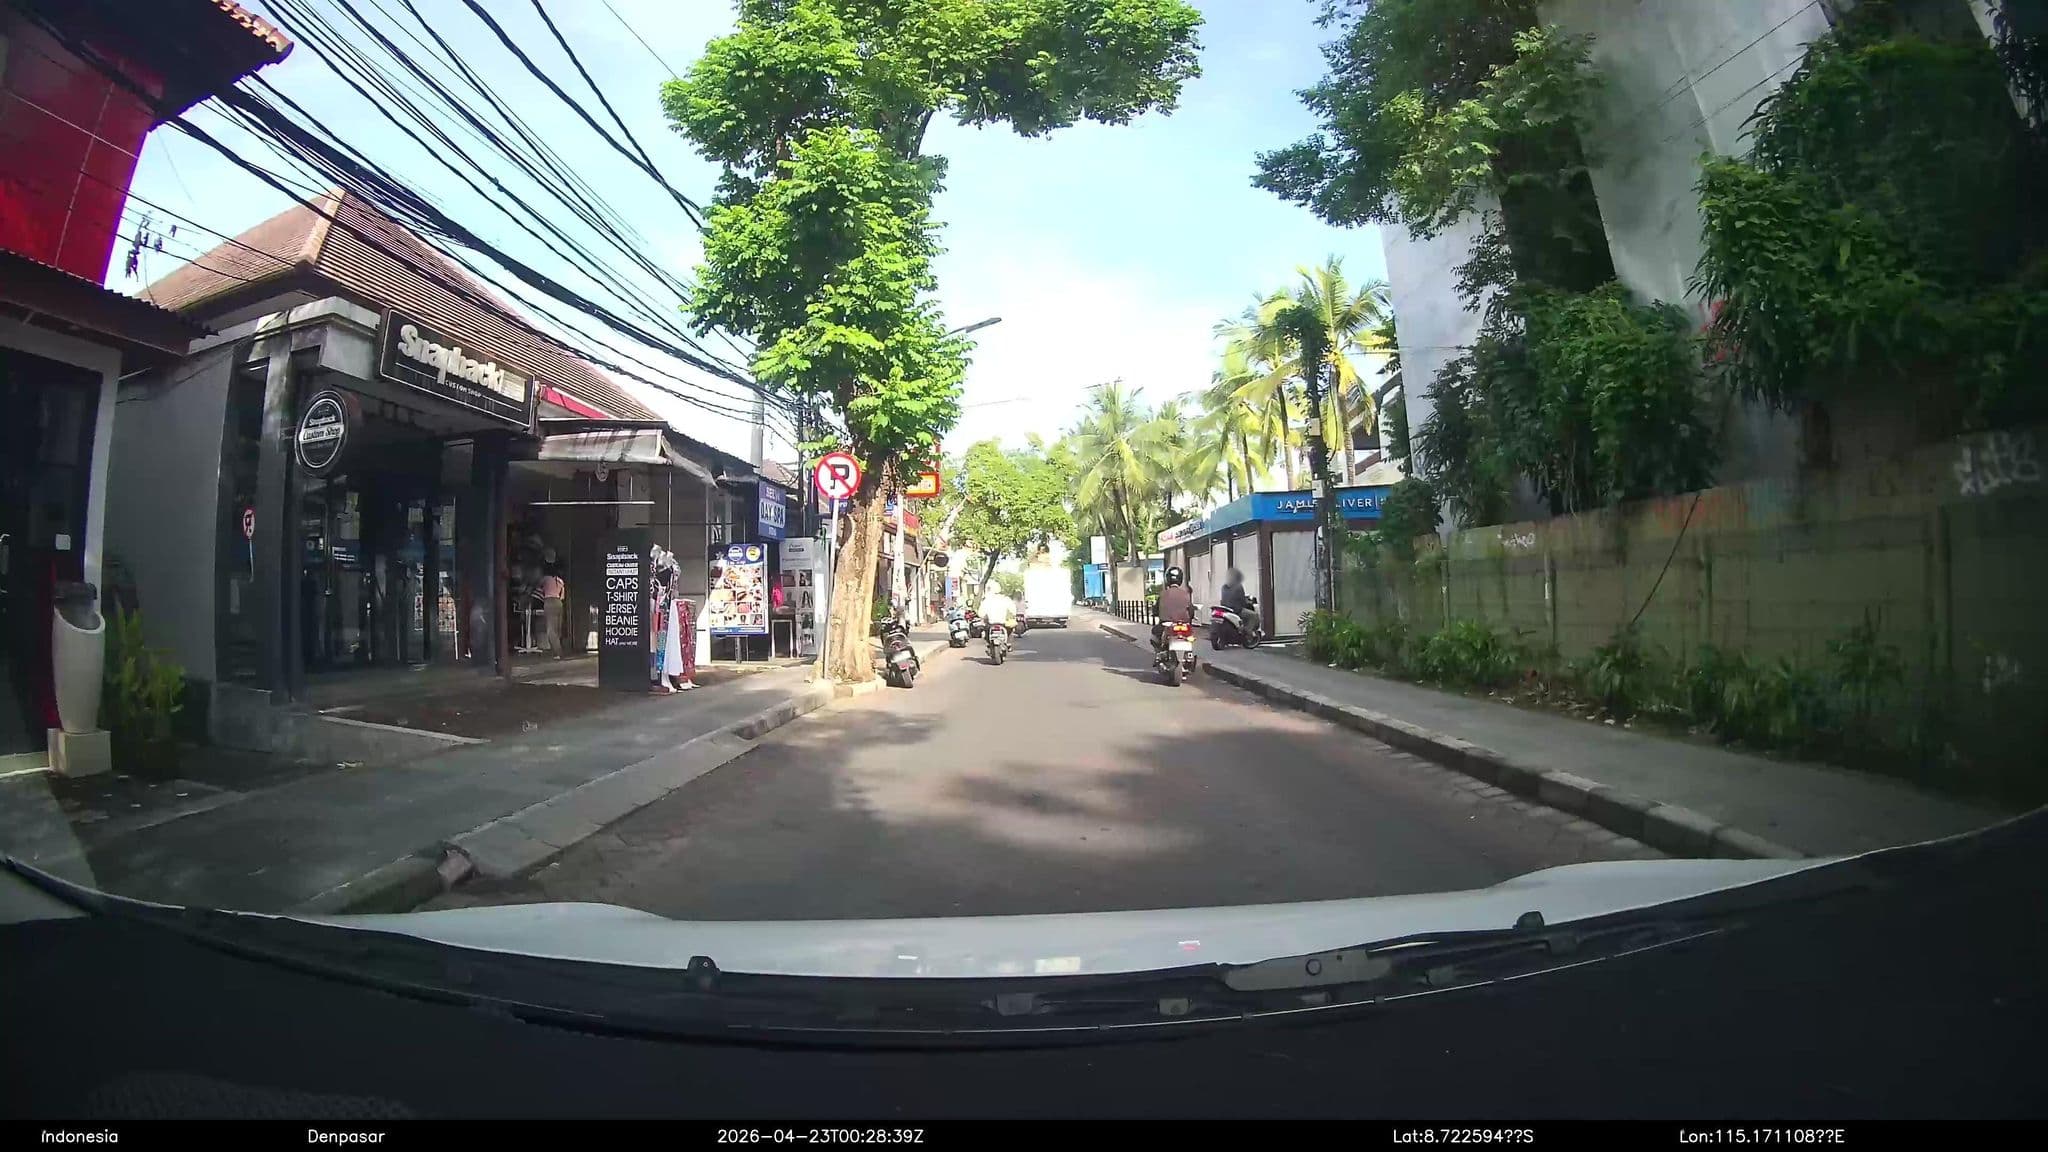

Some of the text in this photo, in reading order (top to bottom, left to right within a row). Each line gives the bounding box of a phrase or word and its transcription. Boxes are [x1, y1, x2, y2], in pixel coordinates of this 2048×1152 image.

[445, 379, 468, 394] CUSTOM
[760, 502, 785, 527] DAY SPA
[606, 577, 639, 590] CAPS
[606, 591, 639, 602] T-SHIRT
[606, 603, 638, 614] JERSEY
[605, 615, 639, 626] BEANIE
[605, 627, 639, 636] HOODIE
[605, 637, 619, 646] HAT
